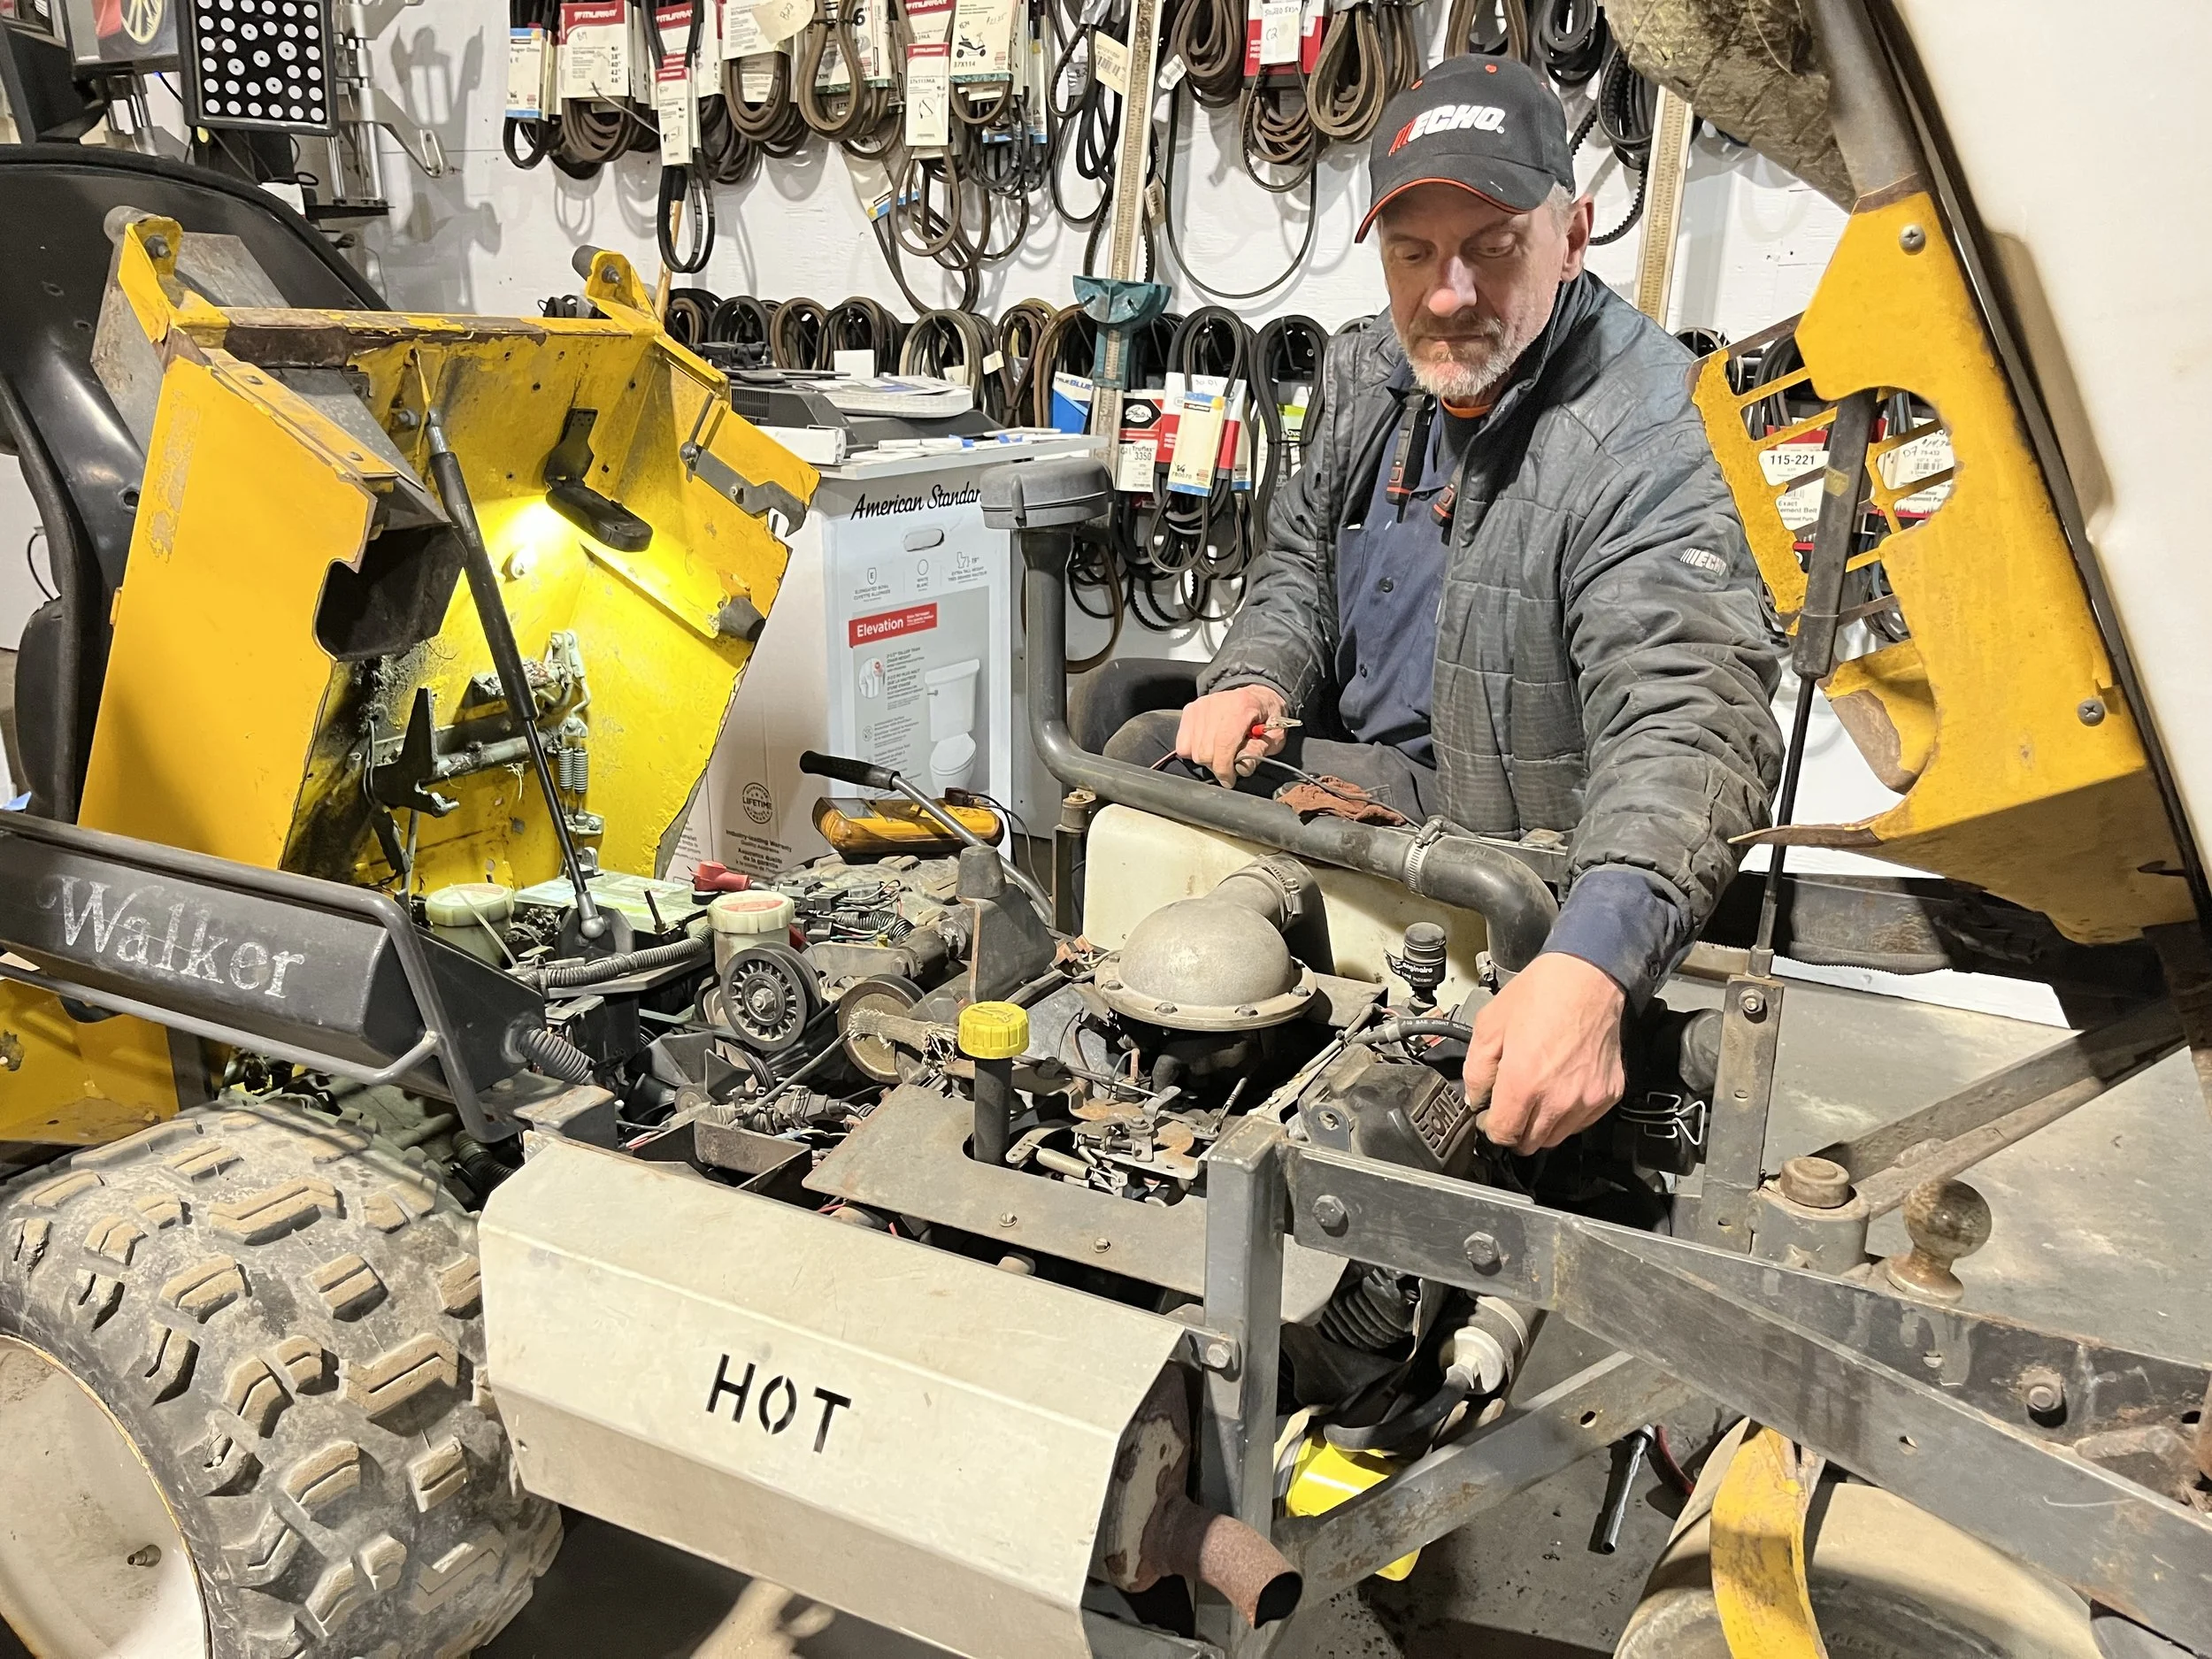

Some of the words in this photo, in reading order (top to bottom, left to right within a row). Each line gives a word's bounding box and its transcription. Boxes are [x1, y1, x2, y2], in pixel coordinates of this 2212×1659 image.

[1406, 104, 1506, 142] ECHO
[1134, 451, 1152, 461] 3350
[1770, 454, 1816, 465] 115-221
[850, 493, 925, 521] American
[926, 481, 981, 510] Standar
[856, 618, 903, 637] Elevation
[743, 796, 772, 810] LIFETIME
[58, 874, 305, 999] Walker
[706, 1353, 852, 1455] HOT
